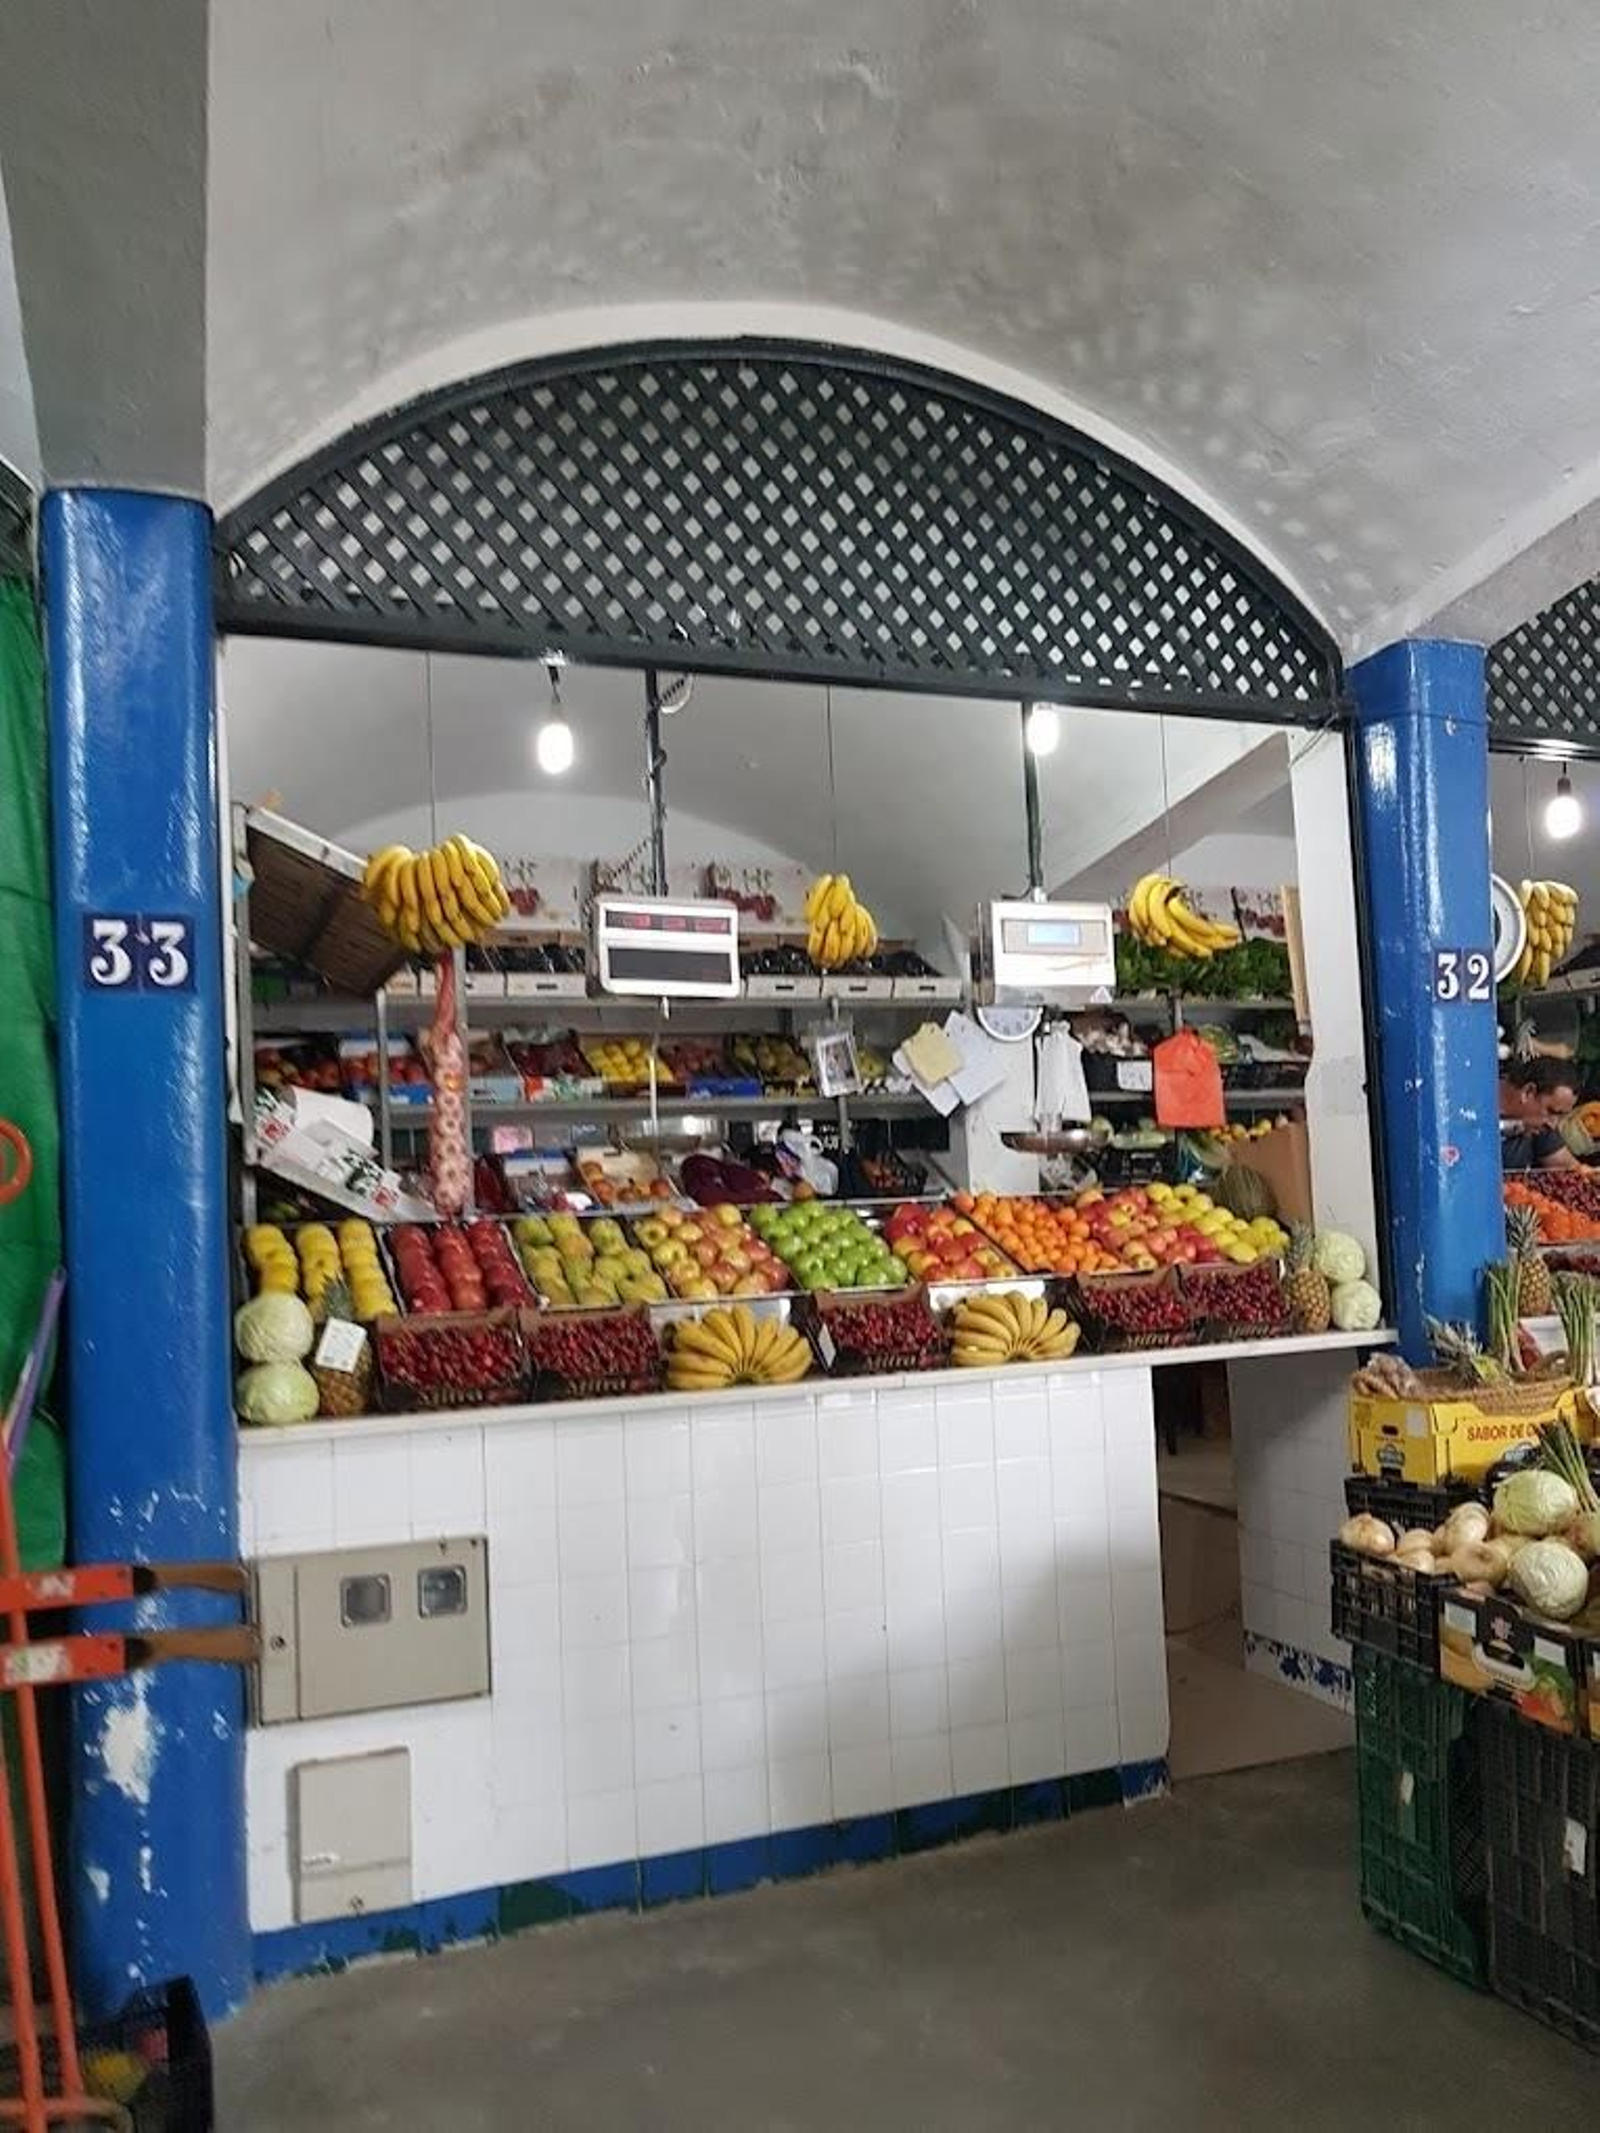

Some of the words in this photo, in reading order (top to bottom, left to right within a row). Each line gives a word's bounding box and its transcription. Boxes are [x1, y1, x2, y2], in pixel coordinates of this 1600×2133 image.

[91, 919, 189, 986] 33
[1437, 952, 1490, 1000] 32
[1467, 1424, 1508, 1442] SABOR
[1510, 1422, 1526, 1439] DE
